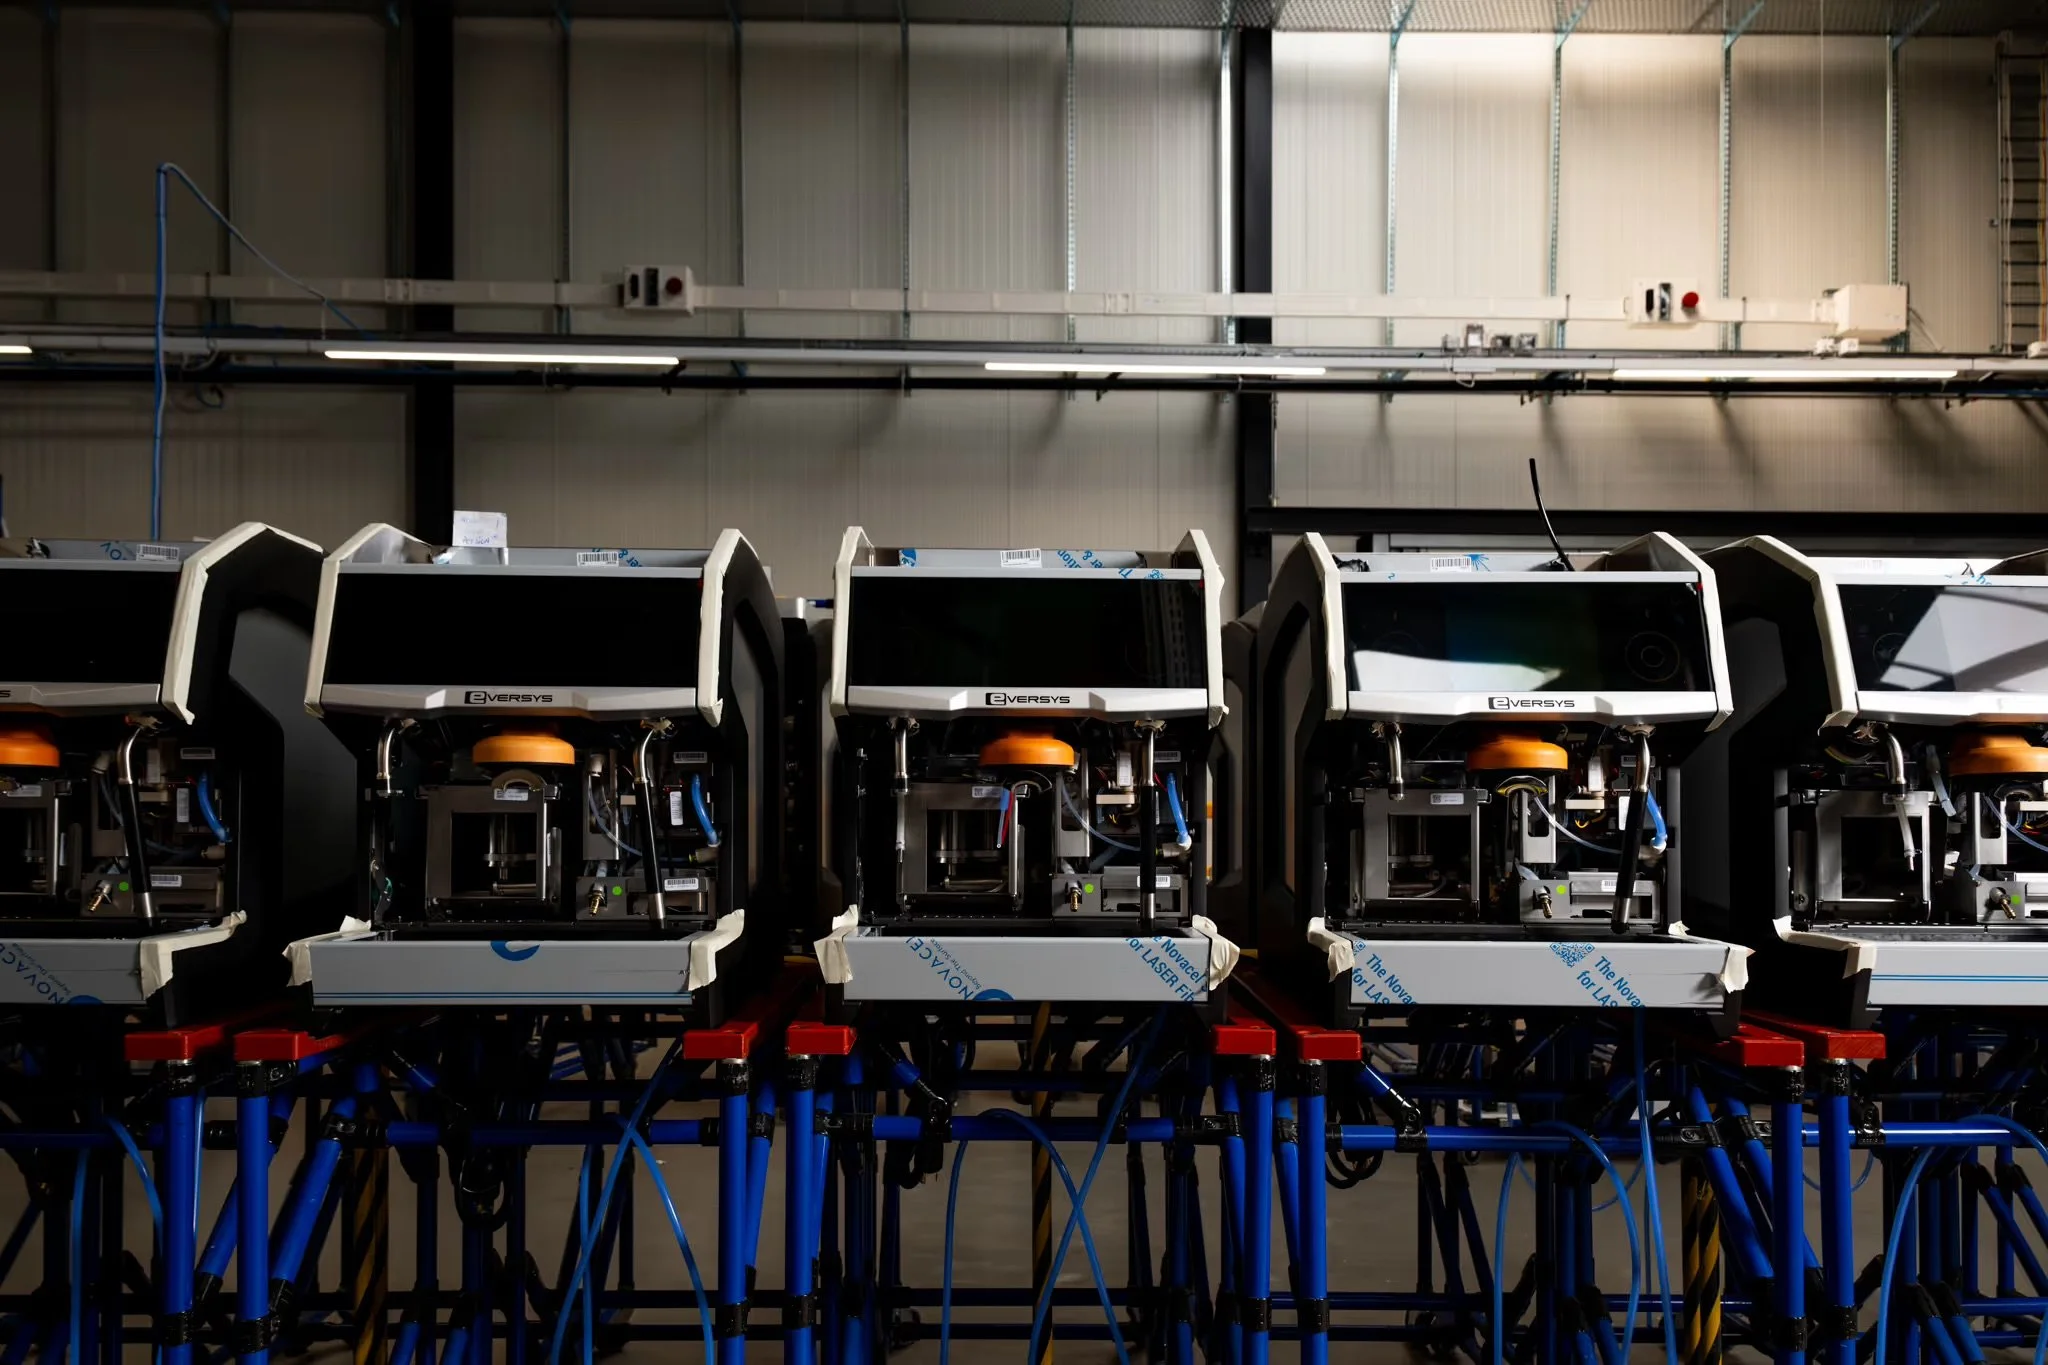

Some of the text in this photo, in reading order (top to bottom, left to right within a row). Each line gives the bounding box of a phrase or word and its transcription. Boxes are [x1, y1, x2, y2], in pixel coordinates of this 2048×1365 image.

[930, 939, 951, 961] Surface
[1161, 939, 1206, 983] Novacel
[1142, 949, 1179, 987] LASER
[1366, 954, 1386, 978] The
[1595, 956, 1615, 980] The
[961, 969, 982, 990] Beyond
[1577, 970, 1596, 990] for
